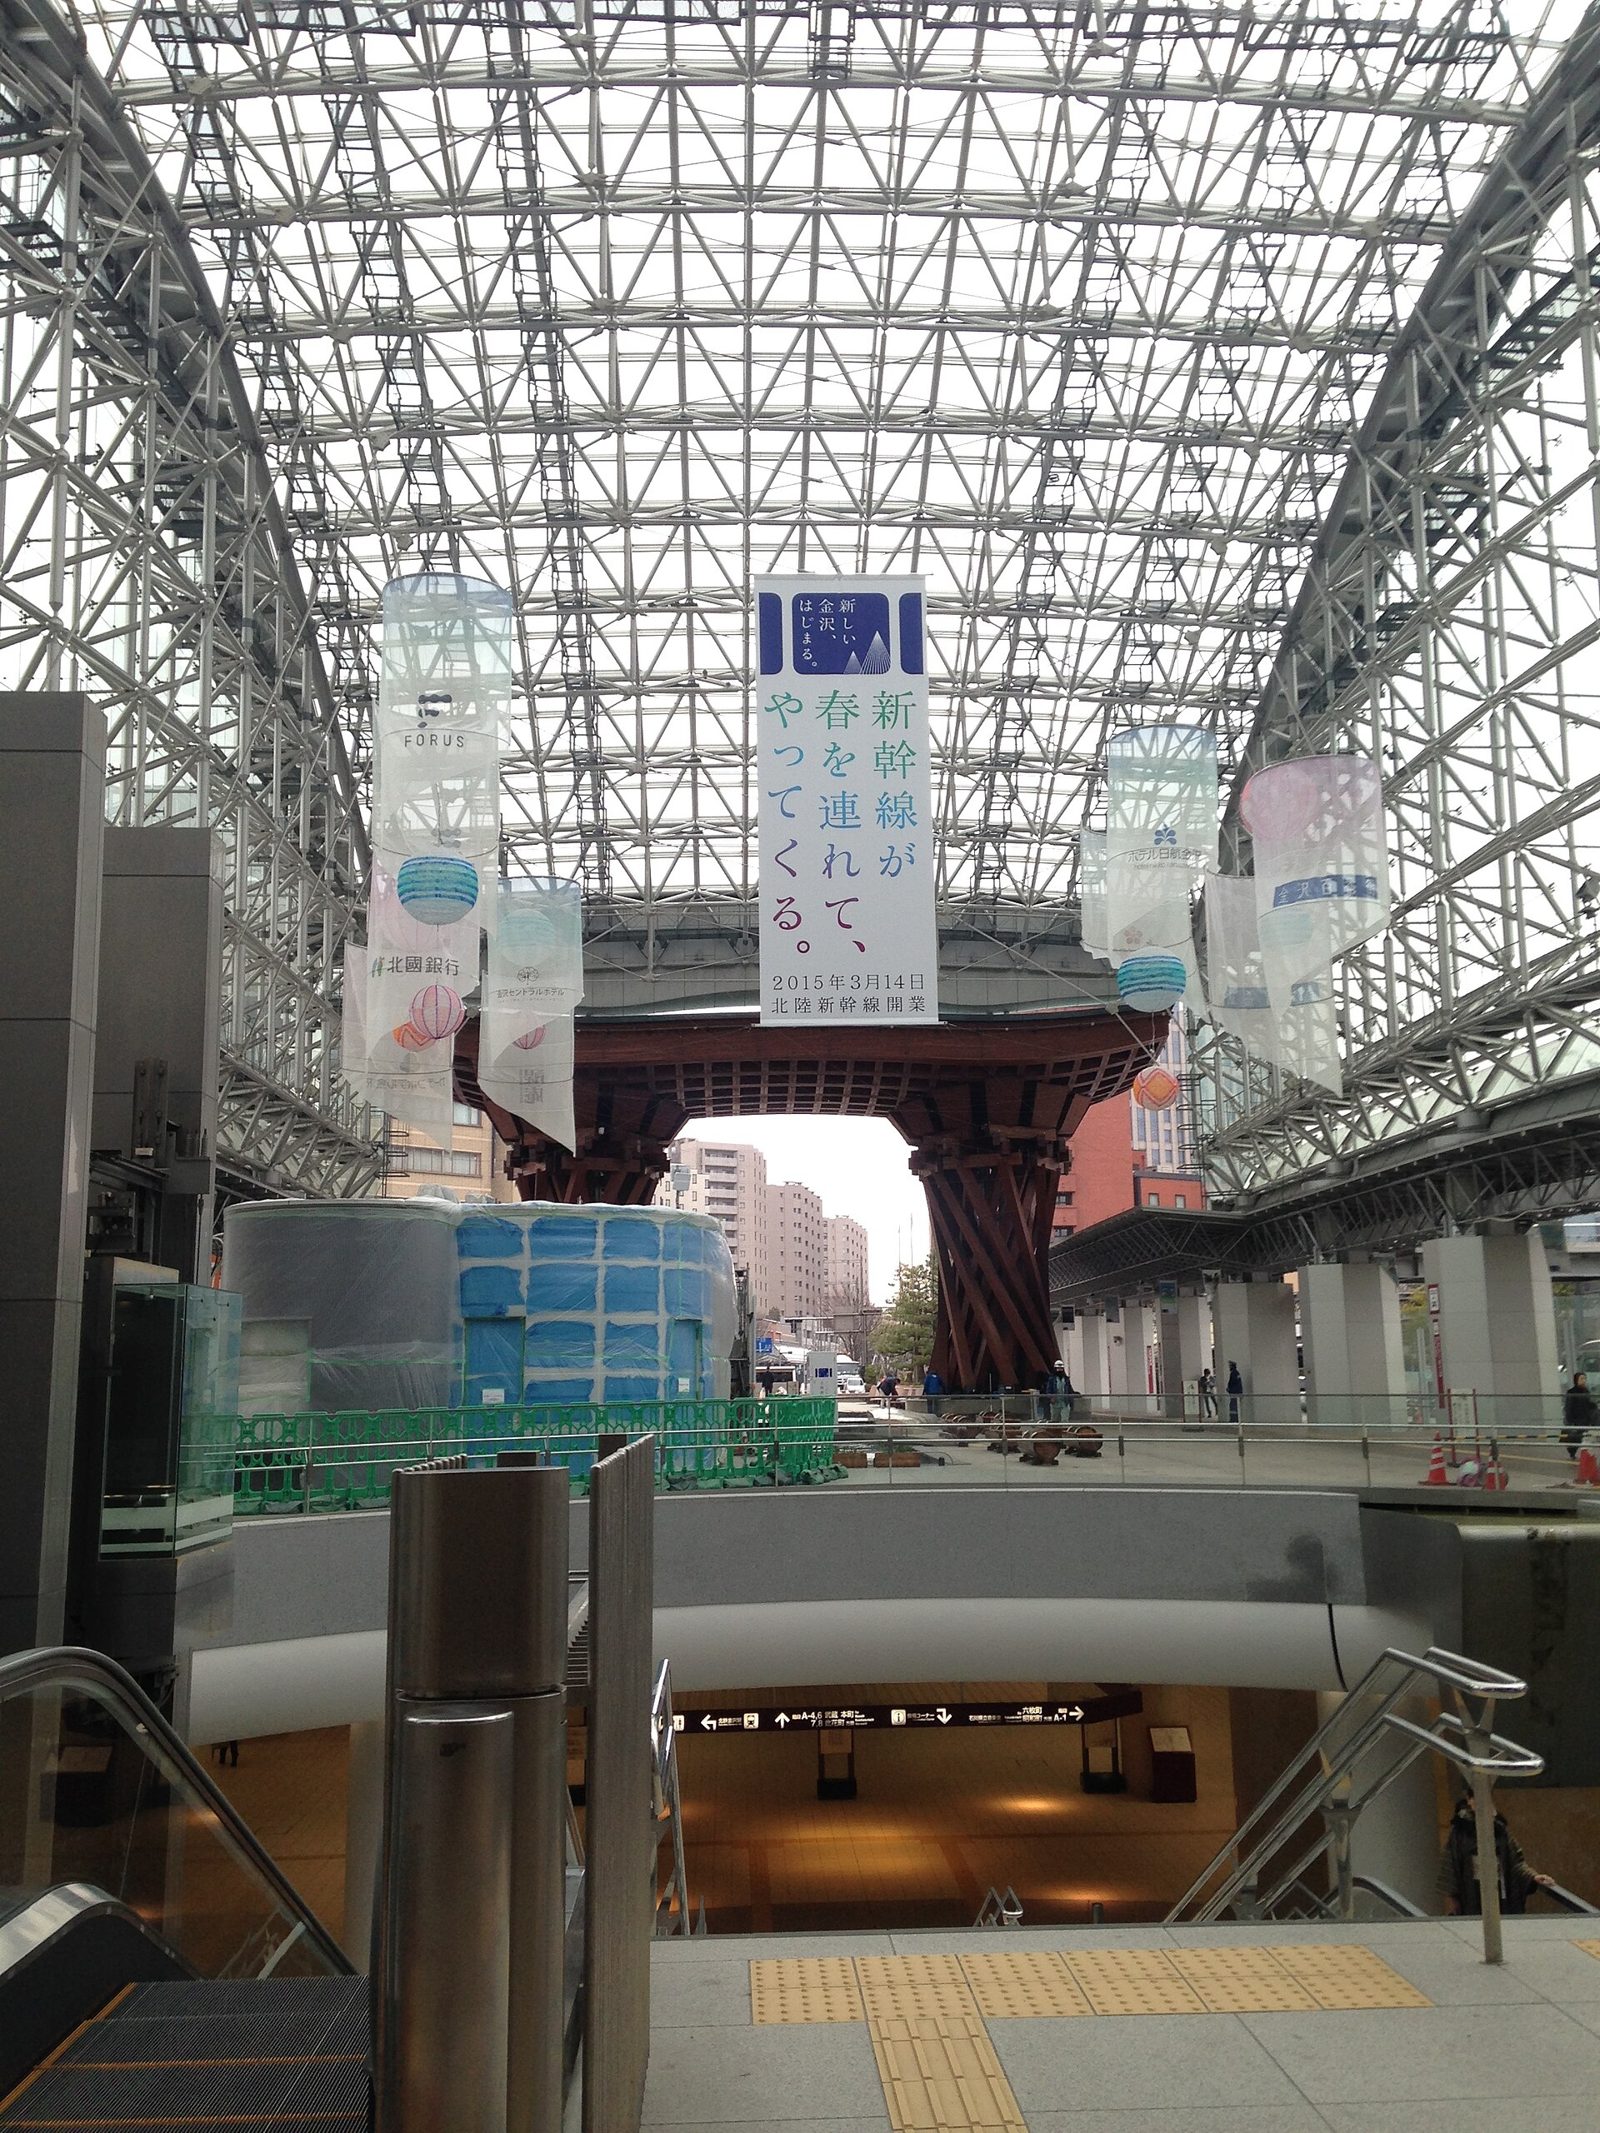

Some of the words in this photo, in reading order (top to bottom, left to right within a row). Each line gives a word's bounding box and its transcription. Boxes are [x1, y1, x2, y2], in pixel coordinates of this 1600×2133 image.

[800, 599, 818, 667] はじまる。
[819, 599, 837, 639] 金沢、
[838, 599, 856, 644] 新しい
[404, 734, 465, 747] FORUS
[871, 690, 917, 878] 新幹線が
[764, 690, 811, 955] やってくる。
[815, 690, 866, 953] 春を連れて、
[387, 956, 459, 976] 北國銀行
[772, 973, 925, 991] 2015年3月14日
[771, 996, 926, 1014] 北陸新幹線開業
